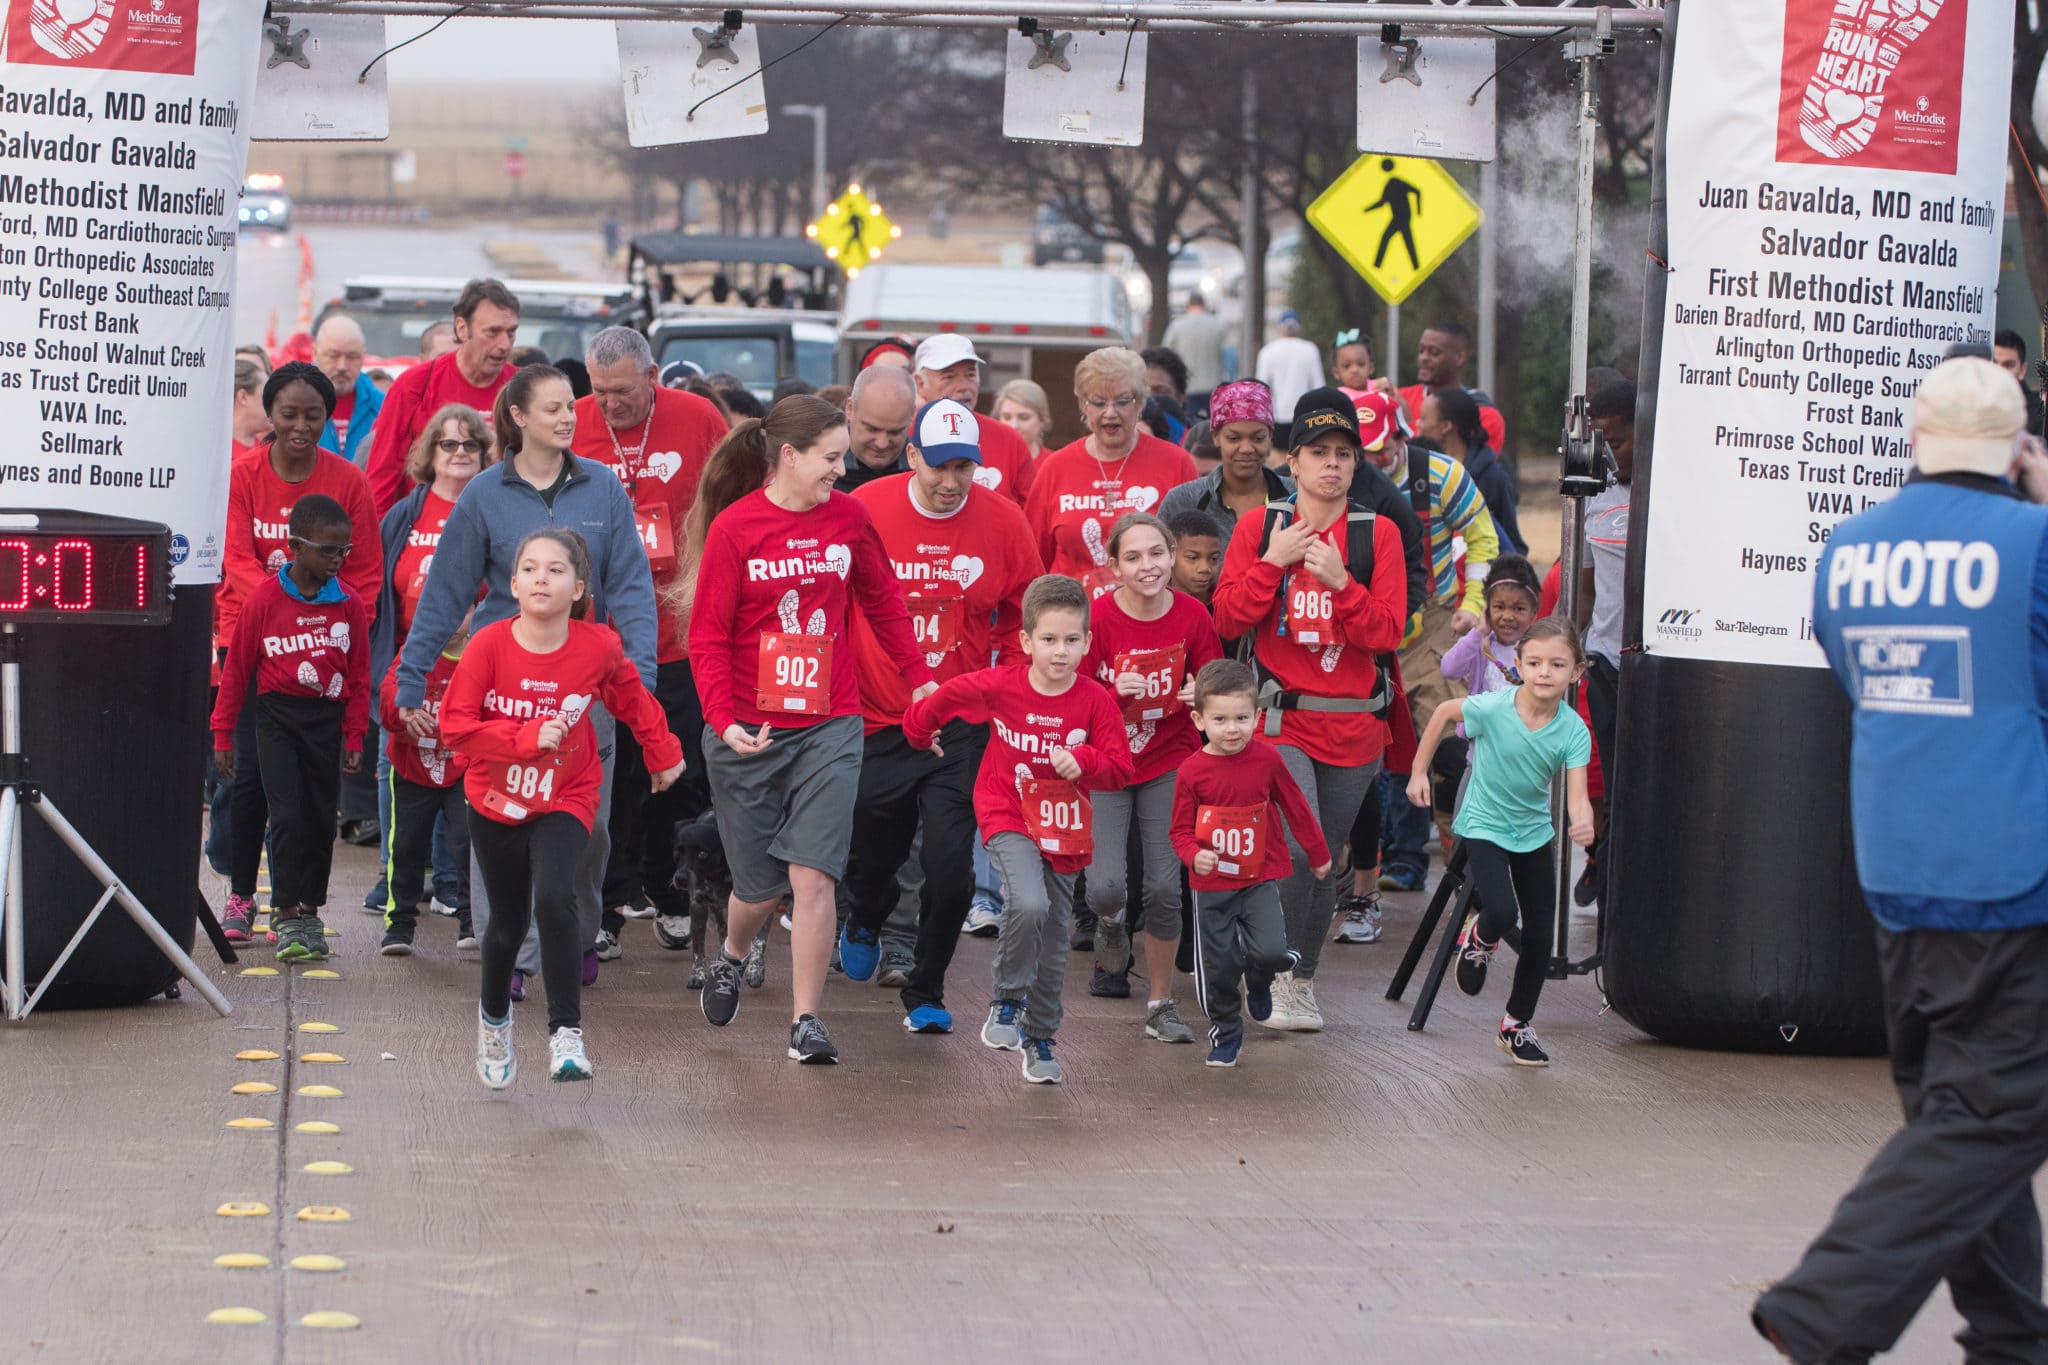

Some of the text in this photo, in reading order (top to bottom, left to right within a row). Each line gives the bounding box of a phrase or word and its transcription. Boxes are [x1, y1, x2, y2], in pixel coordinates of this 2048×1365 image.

[128, 9, 182, 25] Methodist
[1823, 27, 1880, 63] RUN
[1817, 51, 1891, 93] HEART
[0, 84, 239, 135] avalda, MD and family
[1894, 109, 1945, 125] Methodist
[112, 137, 196, 170] Gavalda
[0, 174, 225, 216] Methodist Mansfield
[1699, 181, 1995, 234] Juan Gavalda, MD and family
[46, 215, 77, 237] MD
[86, 217, 203, 246] Cardiothoracic
[34, 246, 136, 274] Orthopedic
[142, 252, 215, 277] Associates
[1761, 227, 1957, 267] Salvador Gavalda
[39, 276, 108, 306] College
[115, 281, 194, 307] Southeast
[197, 285, 230, 312] Campus
[1708, 268, 1983, 314] First Methodist Mansfield
[39, 308, 139, 334] Frost Bank
[1675, 303, 1718, 326] Darien
[1724, 306, 1805, 334] Bradford,
[1814, 311, 1845, 333] MD
[1853, 314, 1964, 343] Cardiothoracic
[34, 338, 98, 363] School
[106, 343, 166, 368] Walnut
[171, 346, 206, 368] Creek
[1716, 336, 1794, 363] Arlington
[1803, 340, 1901, 369] Orthopedic
[1, 369, 187, 398] as Trust Credit Union
[1679, 364, 1732, 387] Tarrant
[1738, 366, 1799, 394] County
[1806, 370, 1873, 399] College
[40, 400, 127, 426] VAVA Inc.
[943, 413, 963, 435] T
[1806, 401, 1903, 428] Frost Bank
[41, 431, 123, 456] Sellmark
[1715, 425, 1794, 451] Primrose
[1802, 431, 1863, 456] School
[48, 464, 82, 485] and
[90, 465, 143, 488] Boone
[150, 467, 175, 489] LLP
[1739, 457, 1905, 488] Texas Trust Credit
[1059, 494, 1105, 513] Run
[1807, 492, 1853, 514] VAVA
[747, 551, 845, 582] Run with Heart
[932, 567, 969, 581] Heart
[1742, 548, 1807, 574] Haynes
[1827, 539, 2000, 611] PHOTO
[1293, 590, 1333, 620] 986
[263, 627, 348, 658] Run with Heart
[1656, 625, 1702, 637] MANSFIELD
[1715, 619, 1788, 637] Star-Telegram
[531, 680, 558, 689] Methodist
[775, 655, 819, 688] 902
[484, 688, 534, 718] Run
[538, 697, 557, 705] with
[993, 716, 1038, 753] Run
[1043, 731, 1061, 741] with
[1032, 757, 1049, 765] 2018
[506, 764, 554, 802] 984
[1040, 799, 1084, 830] 901
[1212, 827, 1254, 857] 903
